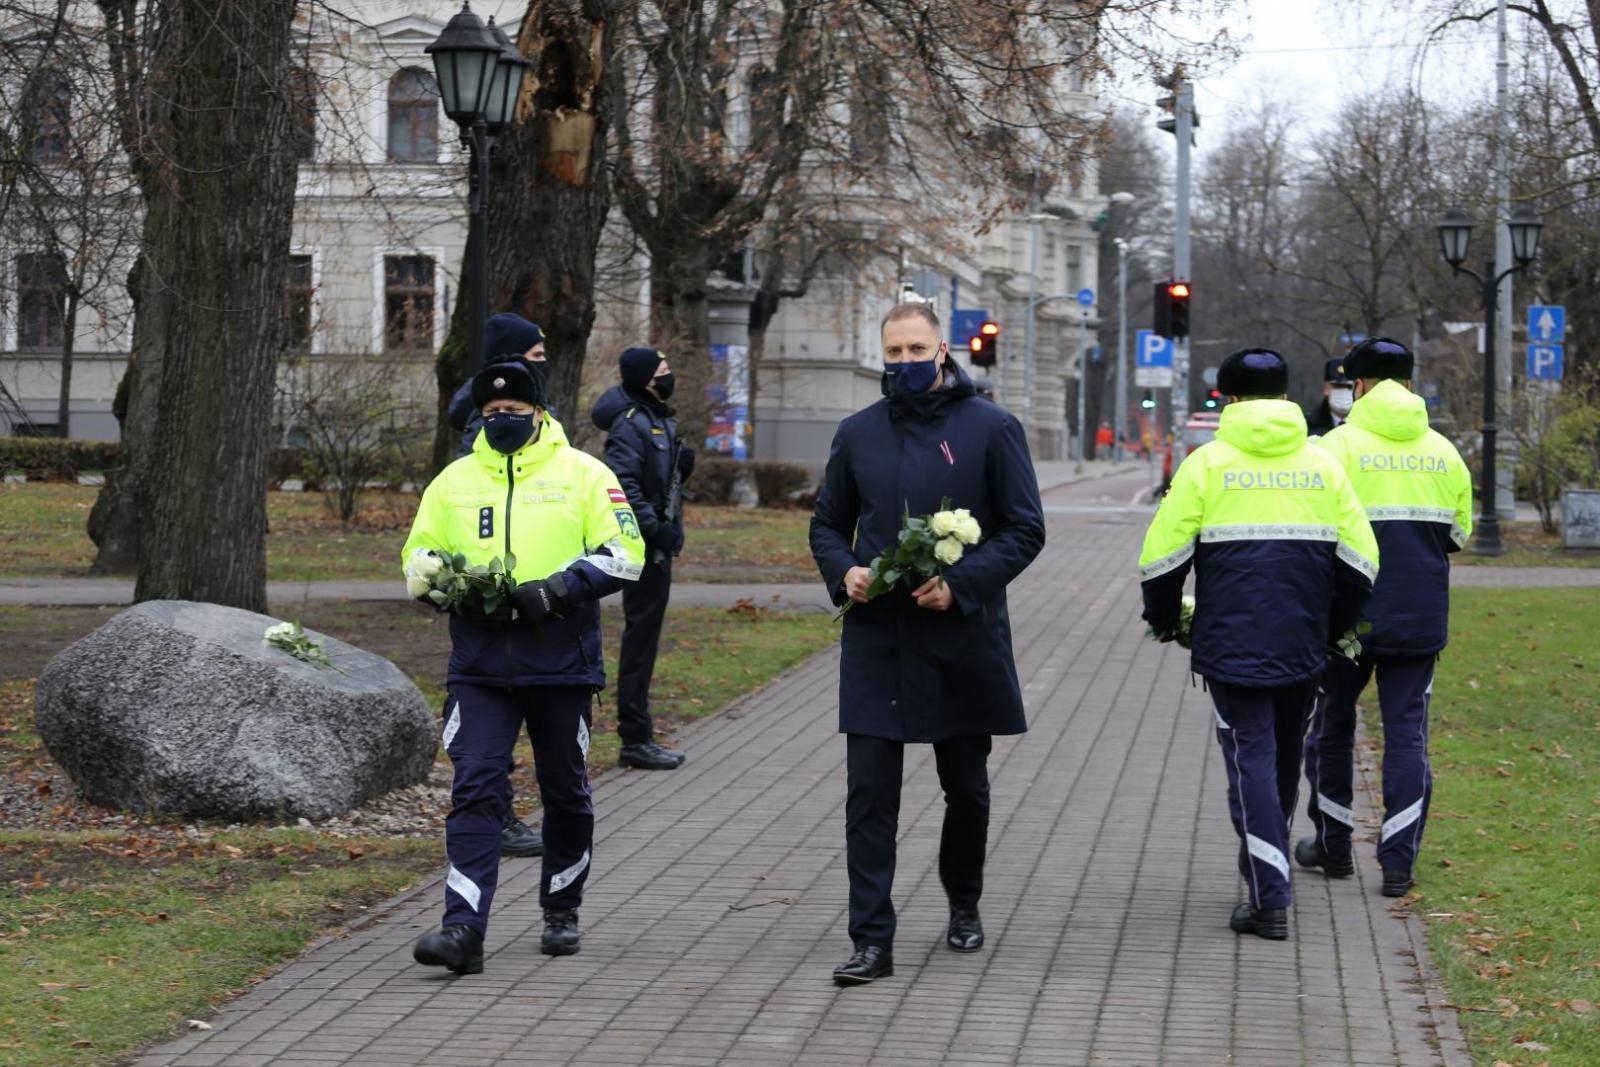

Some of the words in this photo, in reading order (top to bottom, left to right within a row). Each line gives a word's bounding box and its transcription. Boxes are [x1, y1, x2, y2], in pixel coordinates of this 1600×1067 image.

[1144, 334, 1166, 363] P
[1535, 348, 1556, 376] P
[1360, 453, 1447, 473] POLICIJA
[1223, 470, 1325, 489] POLICIJA
